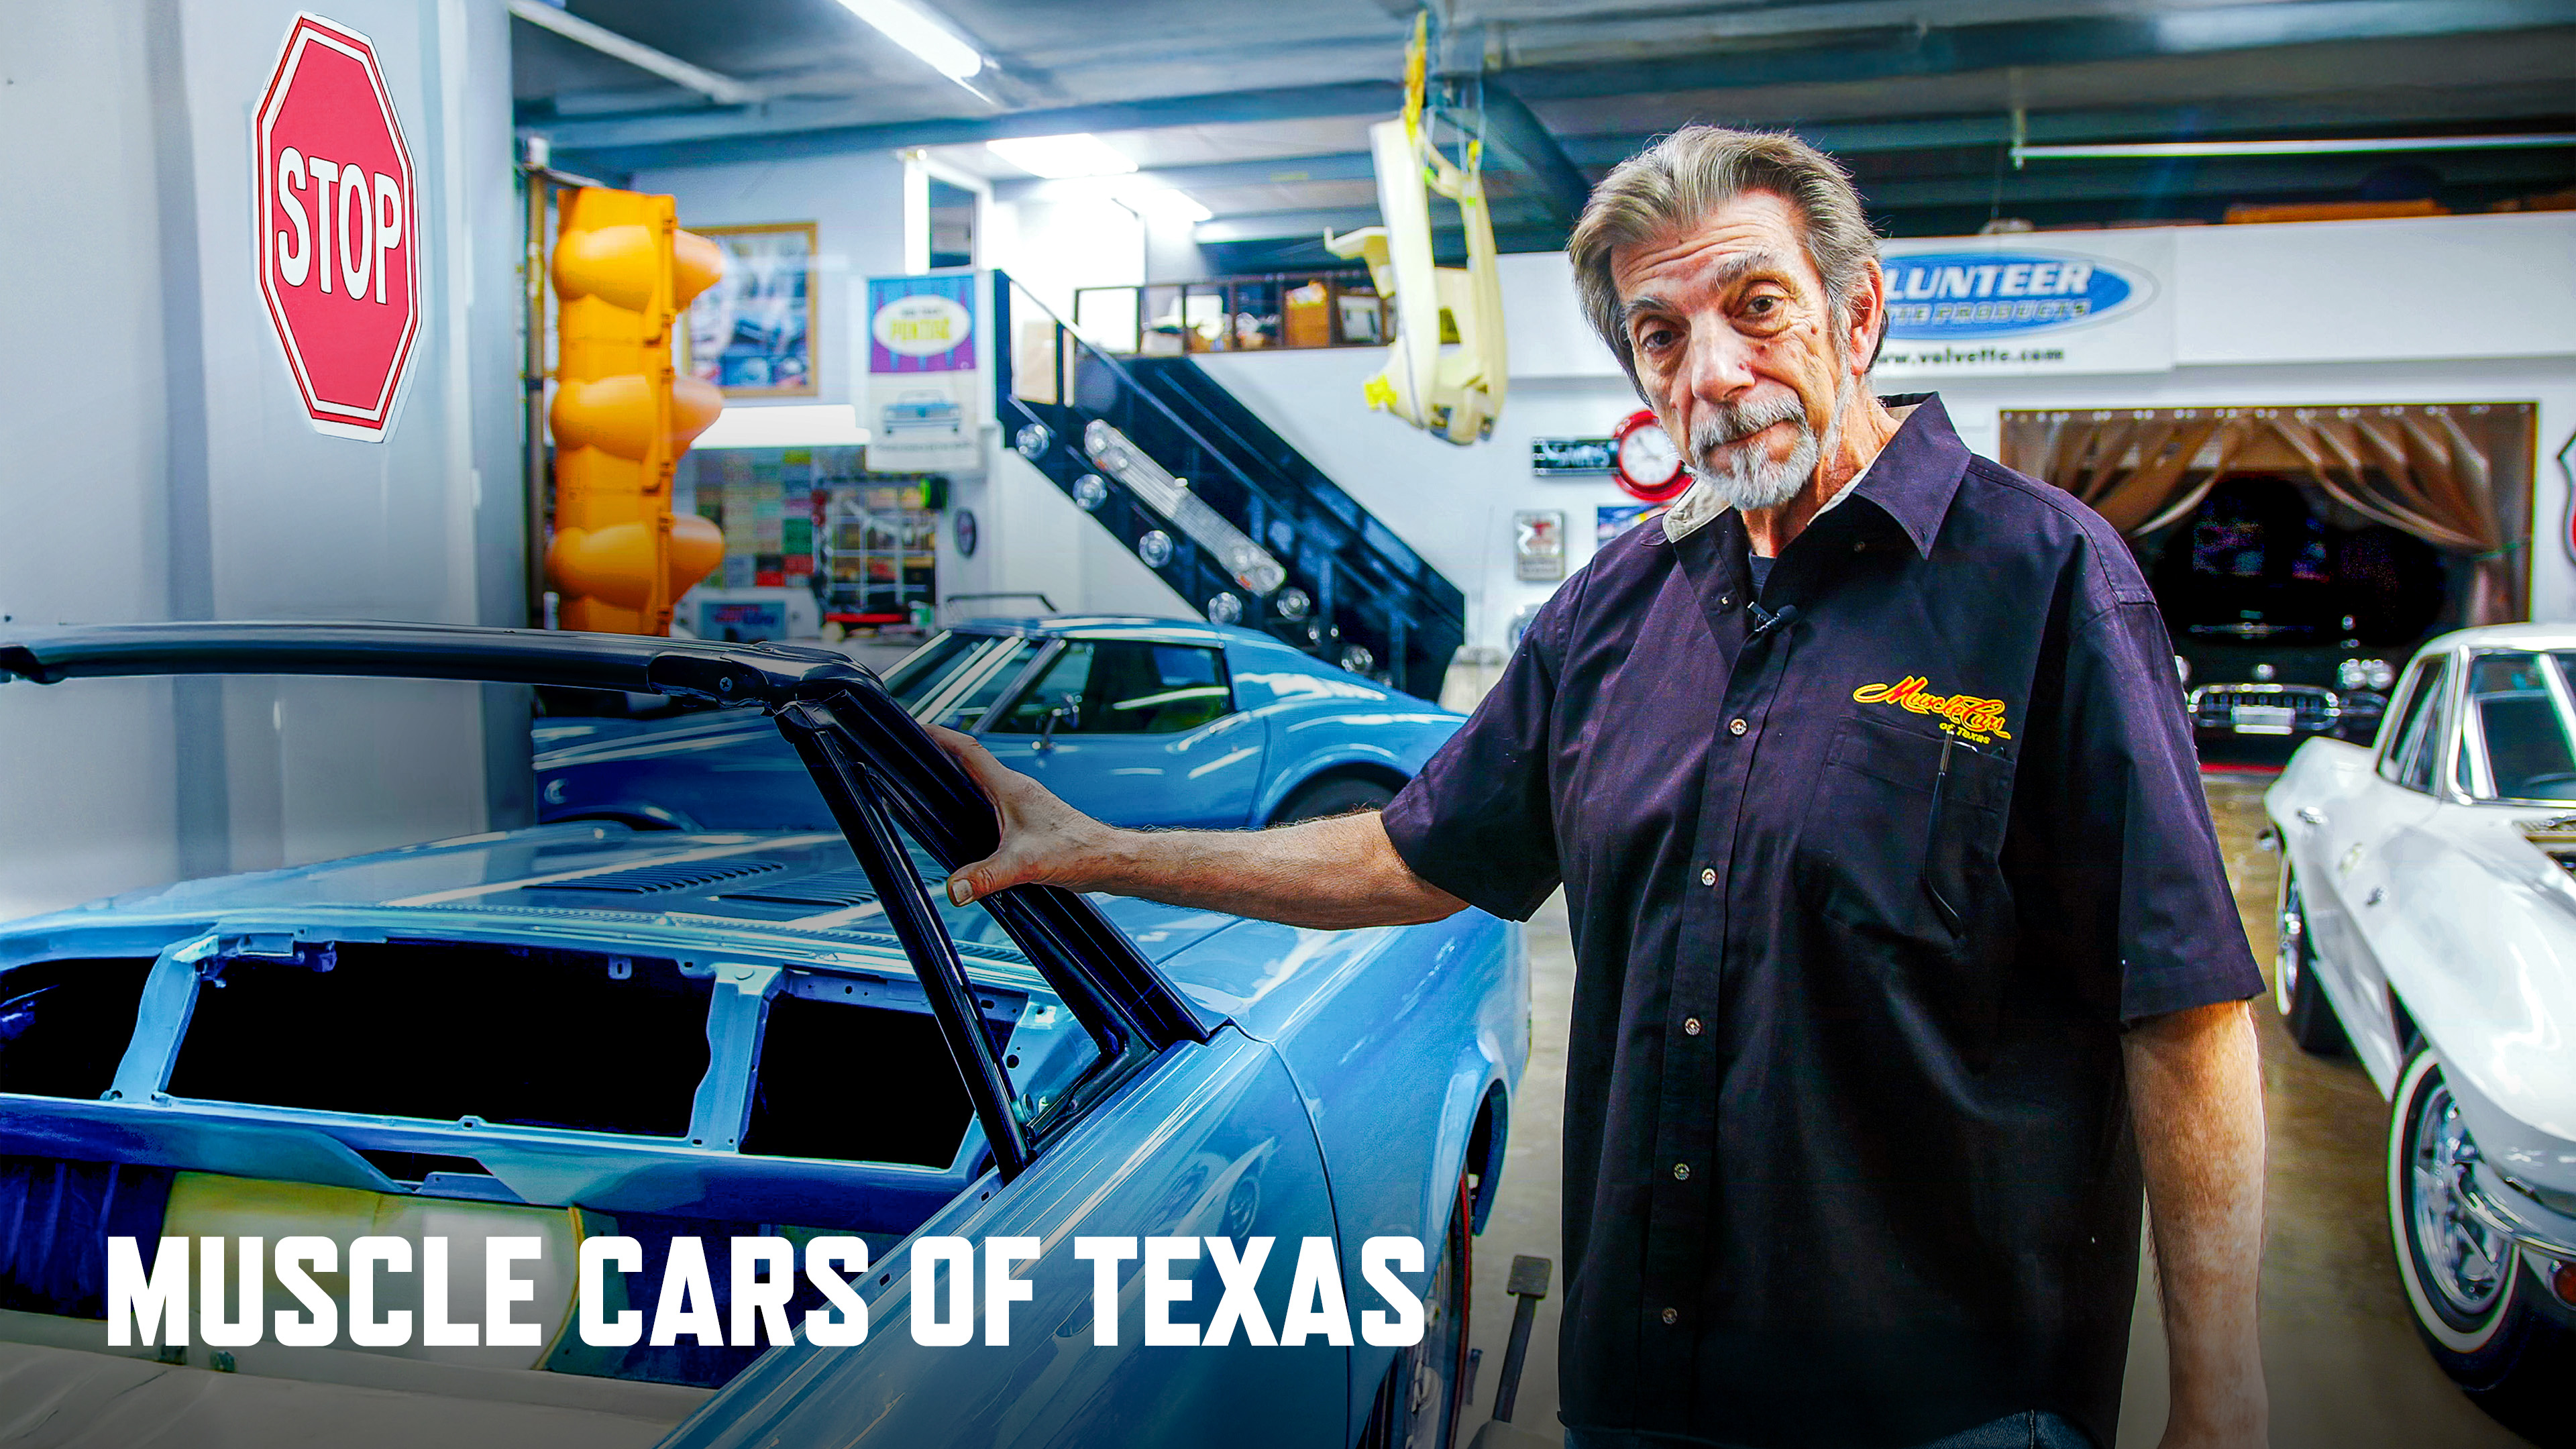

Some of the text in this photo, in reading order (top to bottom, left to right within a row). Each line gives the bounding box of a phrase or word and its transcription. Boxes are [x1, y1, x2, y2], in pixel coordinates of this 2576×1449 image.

[278, 146, 402, 305] STOP
[1883, 261, 2094, 301] LUNTEER
[1933, 298, 2092, 325] PRODUCTS
[1853, 675, 2012, 740] Muscle Cars
[1939, 722, 1991, 745] of Texas
